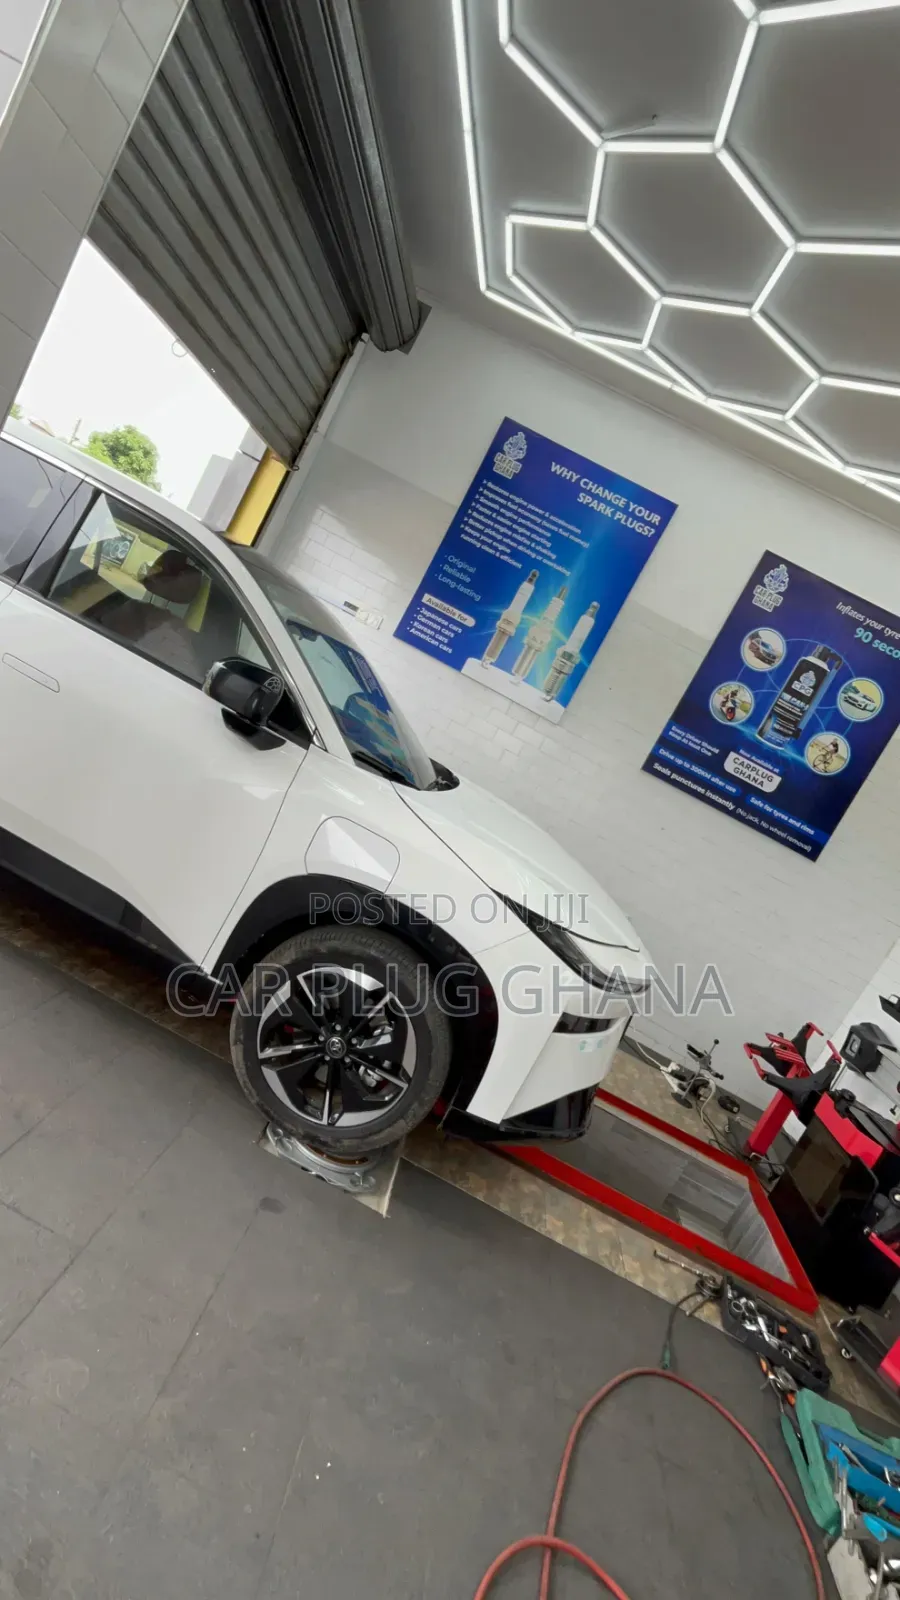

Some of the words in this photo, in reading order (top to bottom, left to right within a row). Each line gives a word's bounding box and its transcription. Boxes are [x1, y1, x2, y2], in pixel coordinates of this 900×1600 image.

[483, 489, 507, 504] Improves
[506, 501, 518, 510] fuel
[517, 507, 542, 523] economy
[508, 494, 527, 506] engine
[526, 503, 545, 514] power
[550, 461, 580, 482] WHY
[579, 478, 627, 507] CHANGE
[628, 501, 660, 525] YOUR
[475, 503, 492, 515] Faster
[512, 523, 530, 536] engine
[530, 533, 551, 547] starting
[479, 496, 499, 510] Smooth
[499, 507, 518, 519] engine
[517, 517, 551, 537] performance
[576, 492, 615, 517] SPARK
[613, 510, 655, 537] PLUGS?
[464, 525, 480, 537] Keeps
[479, 534, 493, 543] your
[492, 541, 510, 553] engine
[468, 518, 484, 530] Better
[483, 527, 503, 539] pickup
[502, 537, 517, 547] when
[517, 545, 536, 558] driving
[493, 523, 512, 535] engine
[460, 533, 481, 547] running
[481, 544, 495, 554] clean
[442, 563, 471, 582] Reliable
[447, 554, 476, 573] Original
[437, 573, 481, 601] Long-lasting
[419, 607, 448, 625] Japanese
[448, 623, 462, 633] cars
[425, 597, 456, 616] Available
[457, 613, 467, 622] for
[836, 602, 865, 621] Inflates
[863, 617, 885, 631] your
[412, 621, 434, 636] Korean
[434, 633, 448, 643] cars
[416, 614, 441, 630] German
[441, 628, 454, 637] cars
[409, 627, 439, 646] American
[438, 643, 452, 653] cars
[854, 627, 873, 643] 90
[872, 639, 900, 660] seco
[793, 682, 811, 694] CPG
[668, 730, 681, 740] Keep
[700, 747, 711, 756] One
[671, 725, 685, 736] Every
[701, 741, 719, 753] Should
[658, 748, 674, 759] Drive
[710, 776, 725, 786] after
[725, 784, 736, 792] use
[732, 756, 773, 782] CARPLUG
[733, 766, 763, 787] GHANA
[652, 762, 671, 775] Seals
[670, 772, 705, 794] punctures
[705, 789, 735, 810] instantly
[735, 807, 746, 816] (No
[760, 820, 769, 828] No
[769, 825, 787, 837] wheel
[786, 835, 811, 852] removal)
[749, 797, 763, 807] Safe
[763, 804, 773, 812] for
[772, 809, 788, 820] tyres
[787, 818, 801, 827] and
[800, 824, 814, 834] rims
